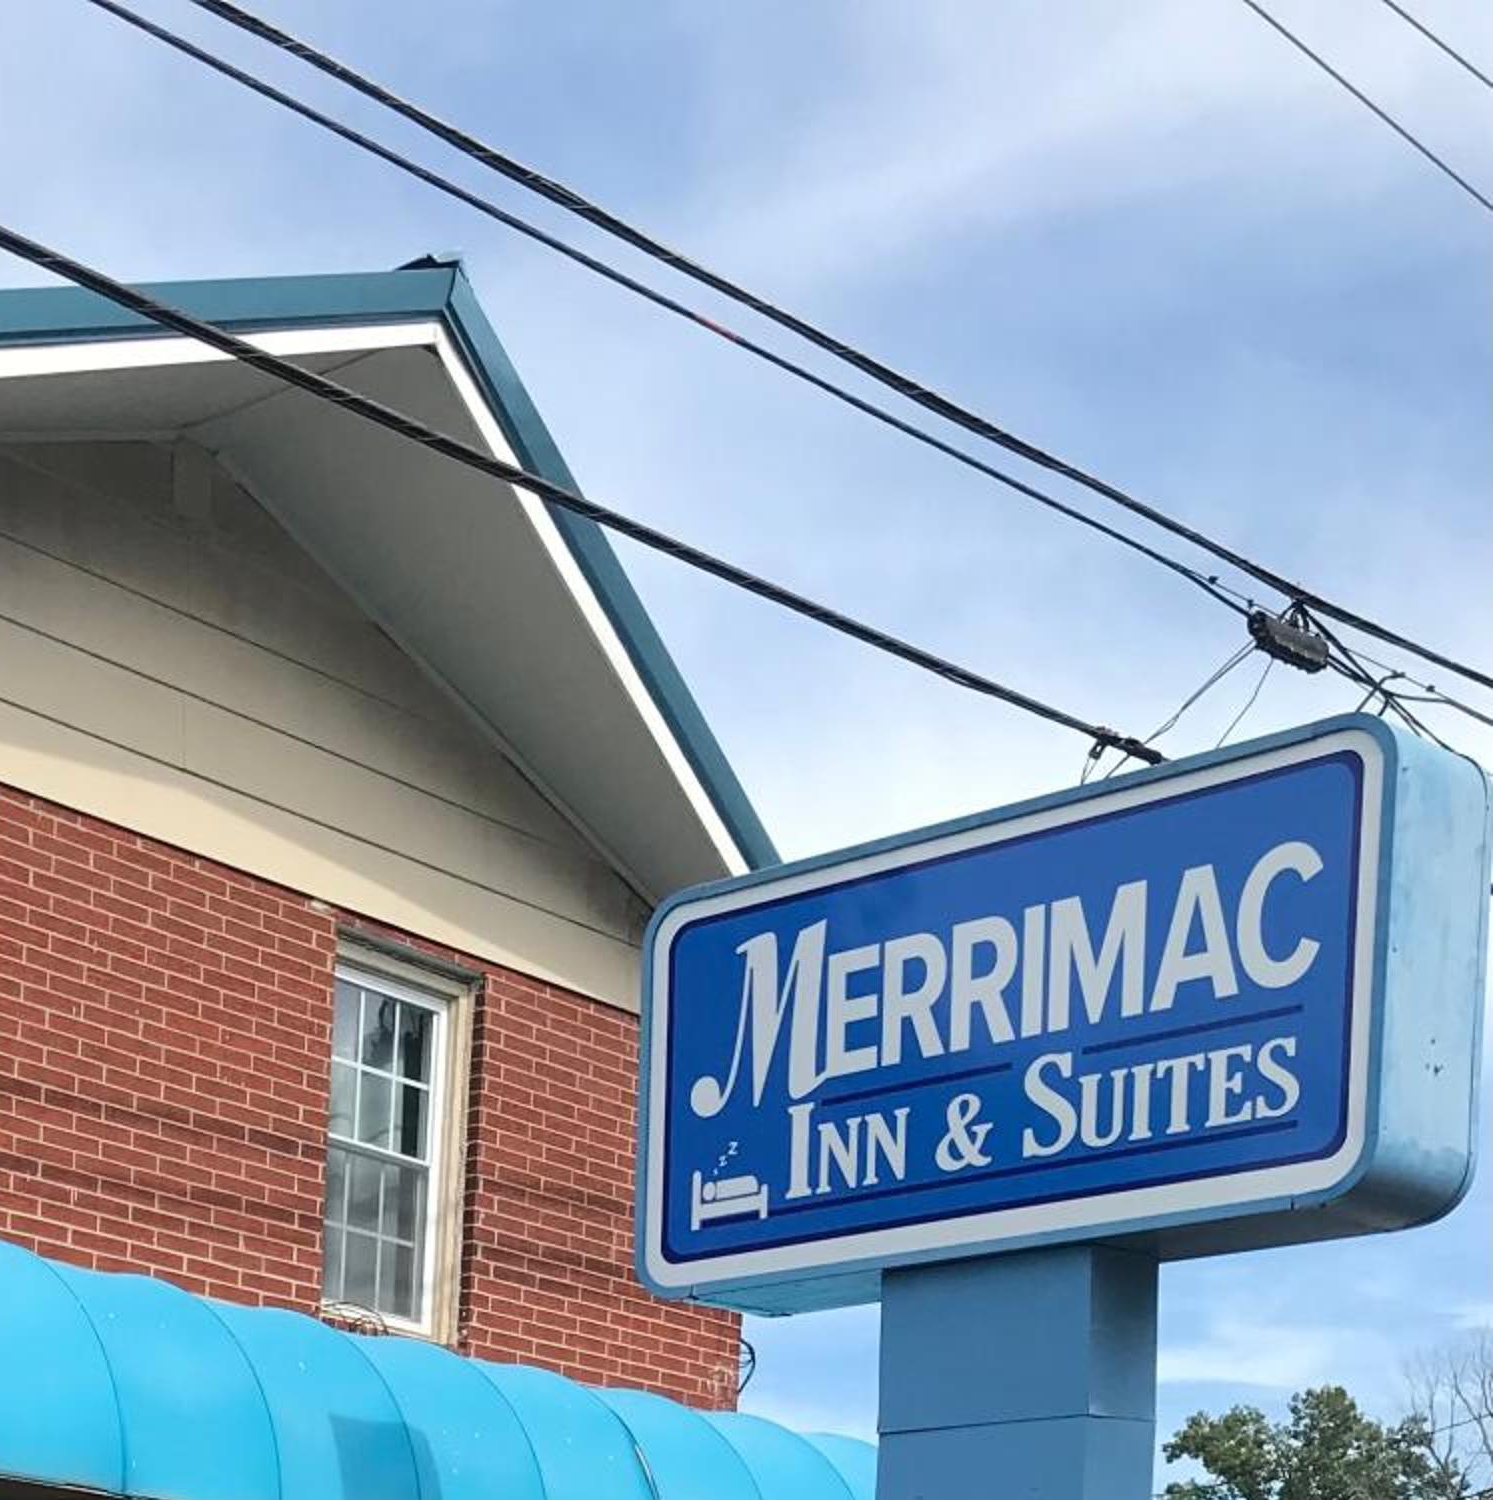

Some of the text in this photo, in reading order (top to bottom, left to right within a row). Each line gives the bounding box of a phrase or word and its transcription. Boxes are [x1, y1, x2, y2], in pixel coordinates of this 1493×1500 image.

[690, 841, 1324, 1117] MERRIMAC
[785, 1037, 1299, 1198] INN & SUITES
